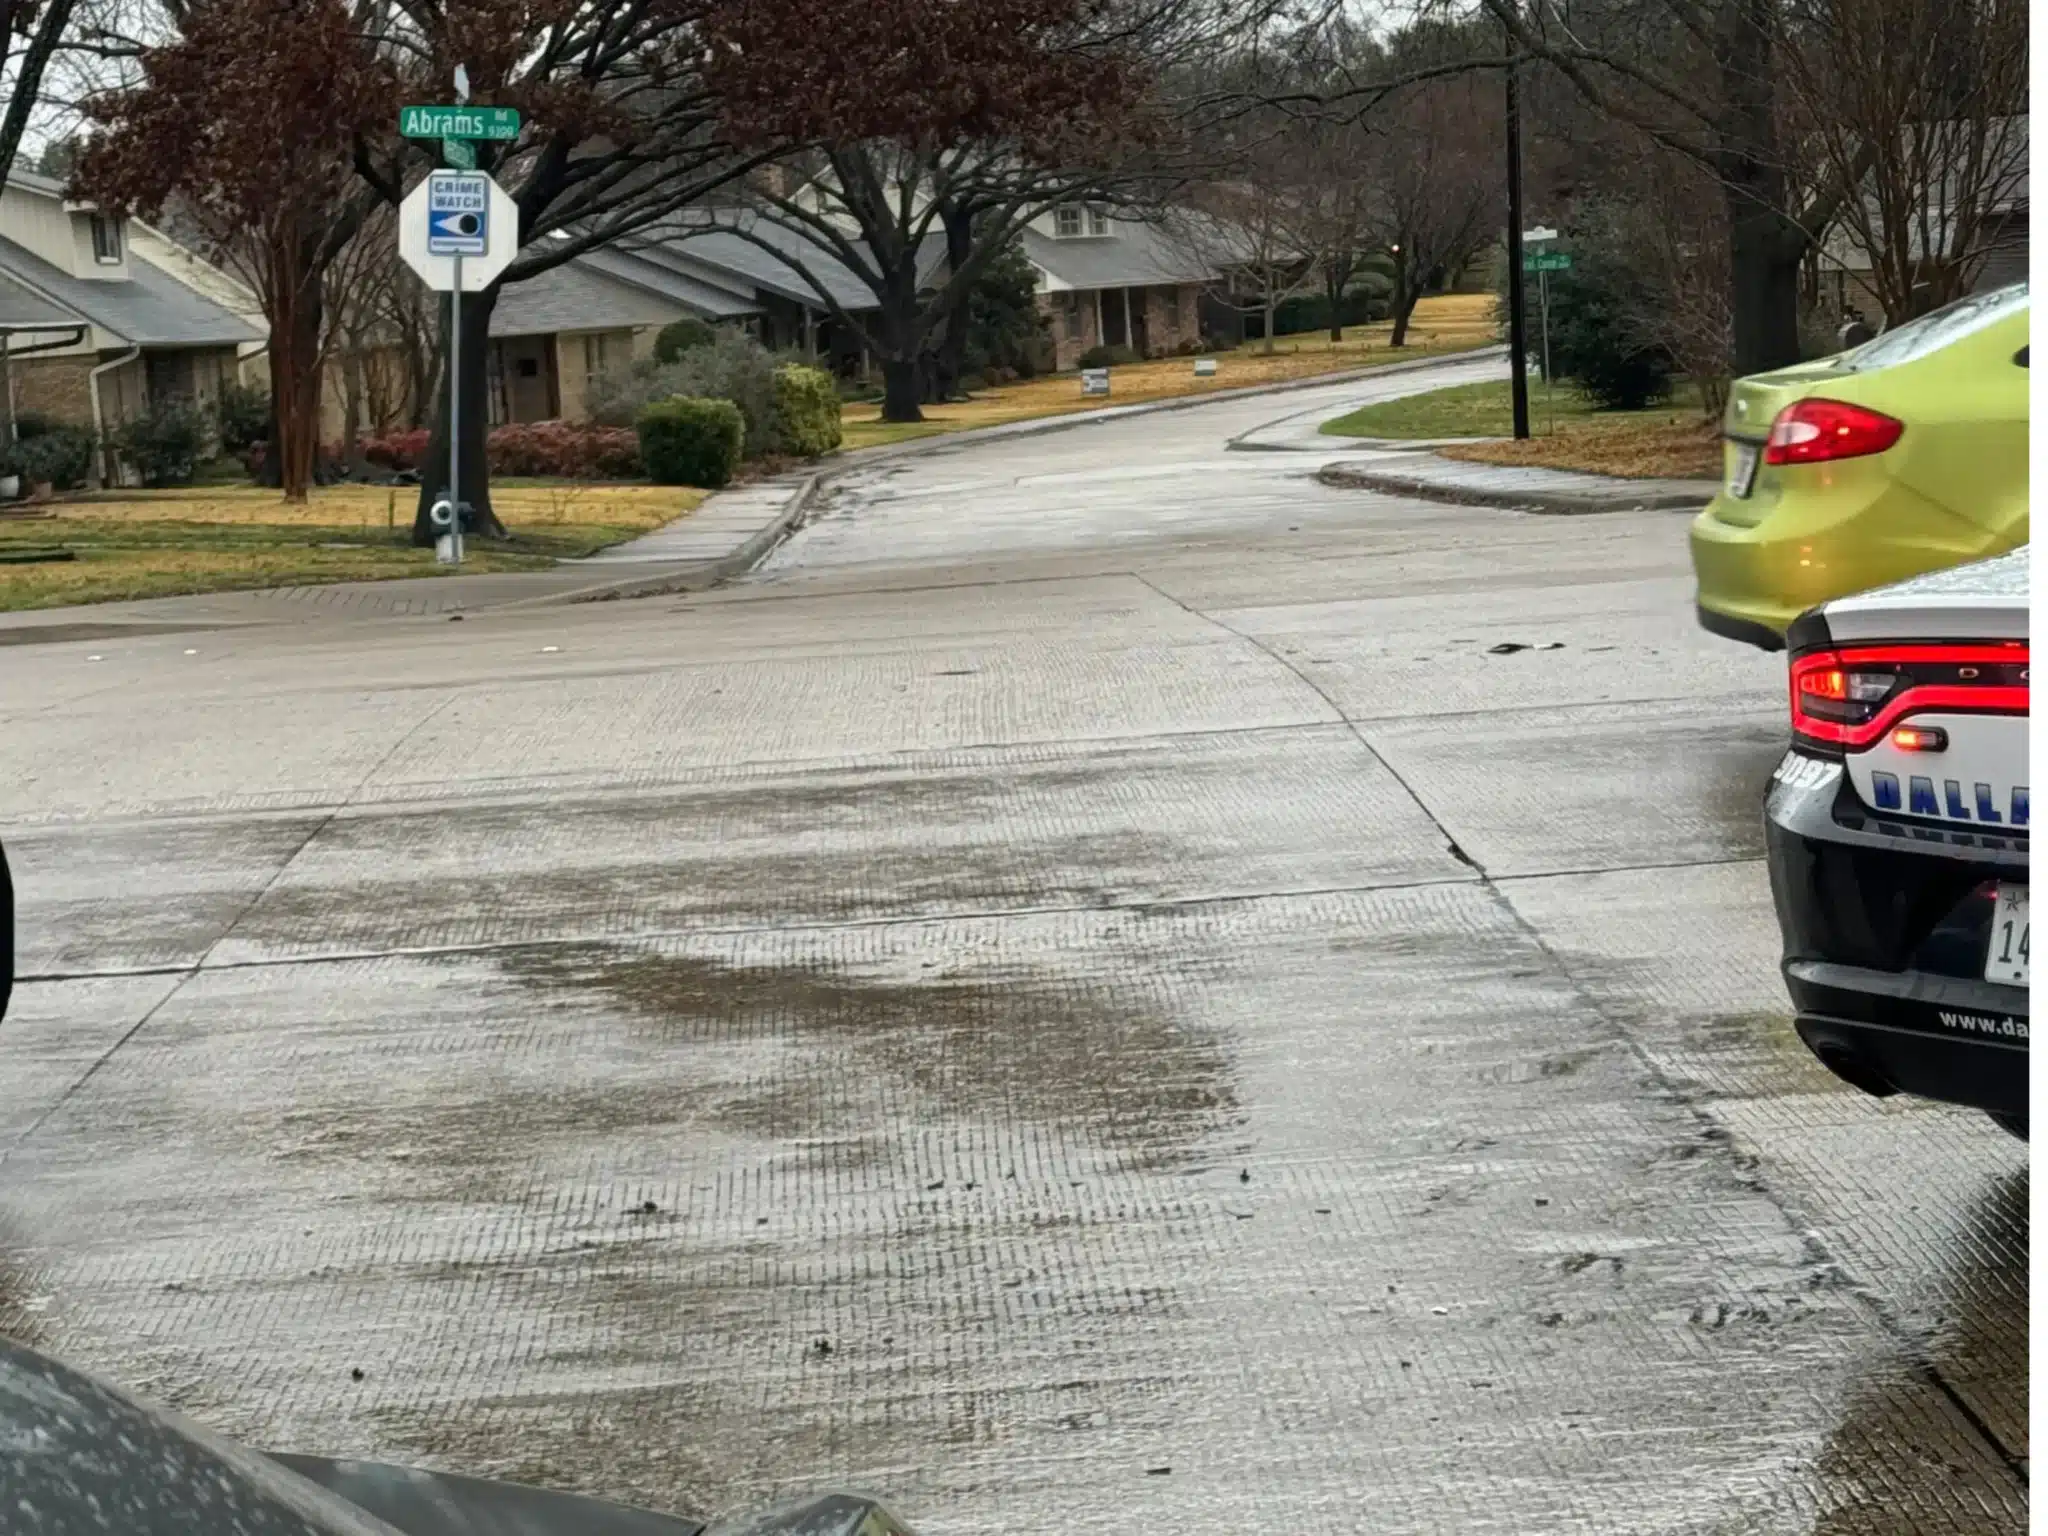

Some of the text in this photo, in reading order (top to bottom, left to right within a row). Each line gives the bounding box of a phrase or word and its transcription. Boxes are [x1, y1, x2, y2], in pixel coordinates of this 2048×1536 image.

[406, 110, 484, 135] Abrams
[434, 181, 482, 193] CRIME
[434, 195, 482, 208] WATCH
[1773, 749, 1843, 791] 9097
